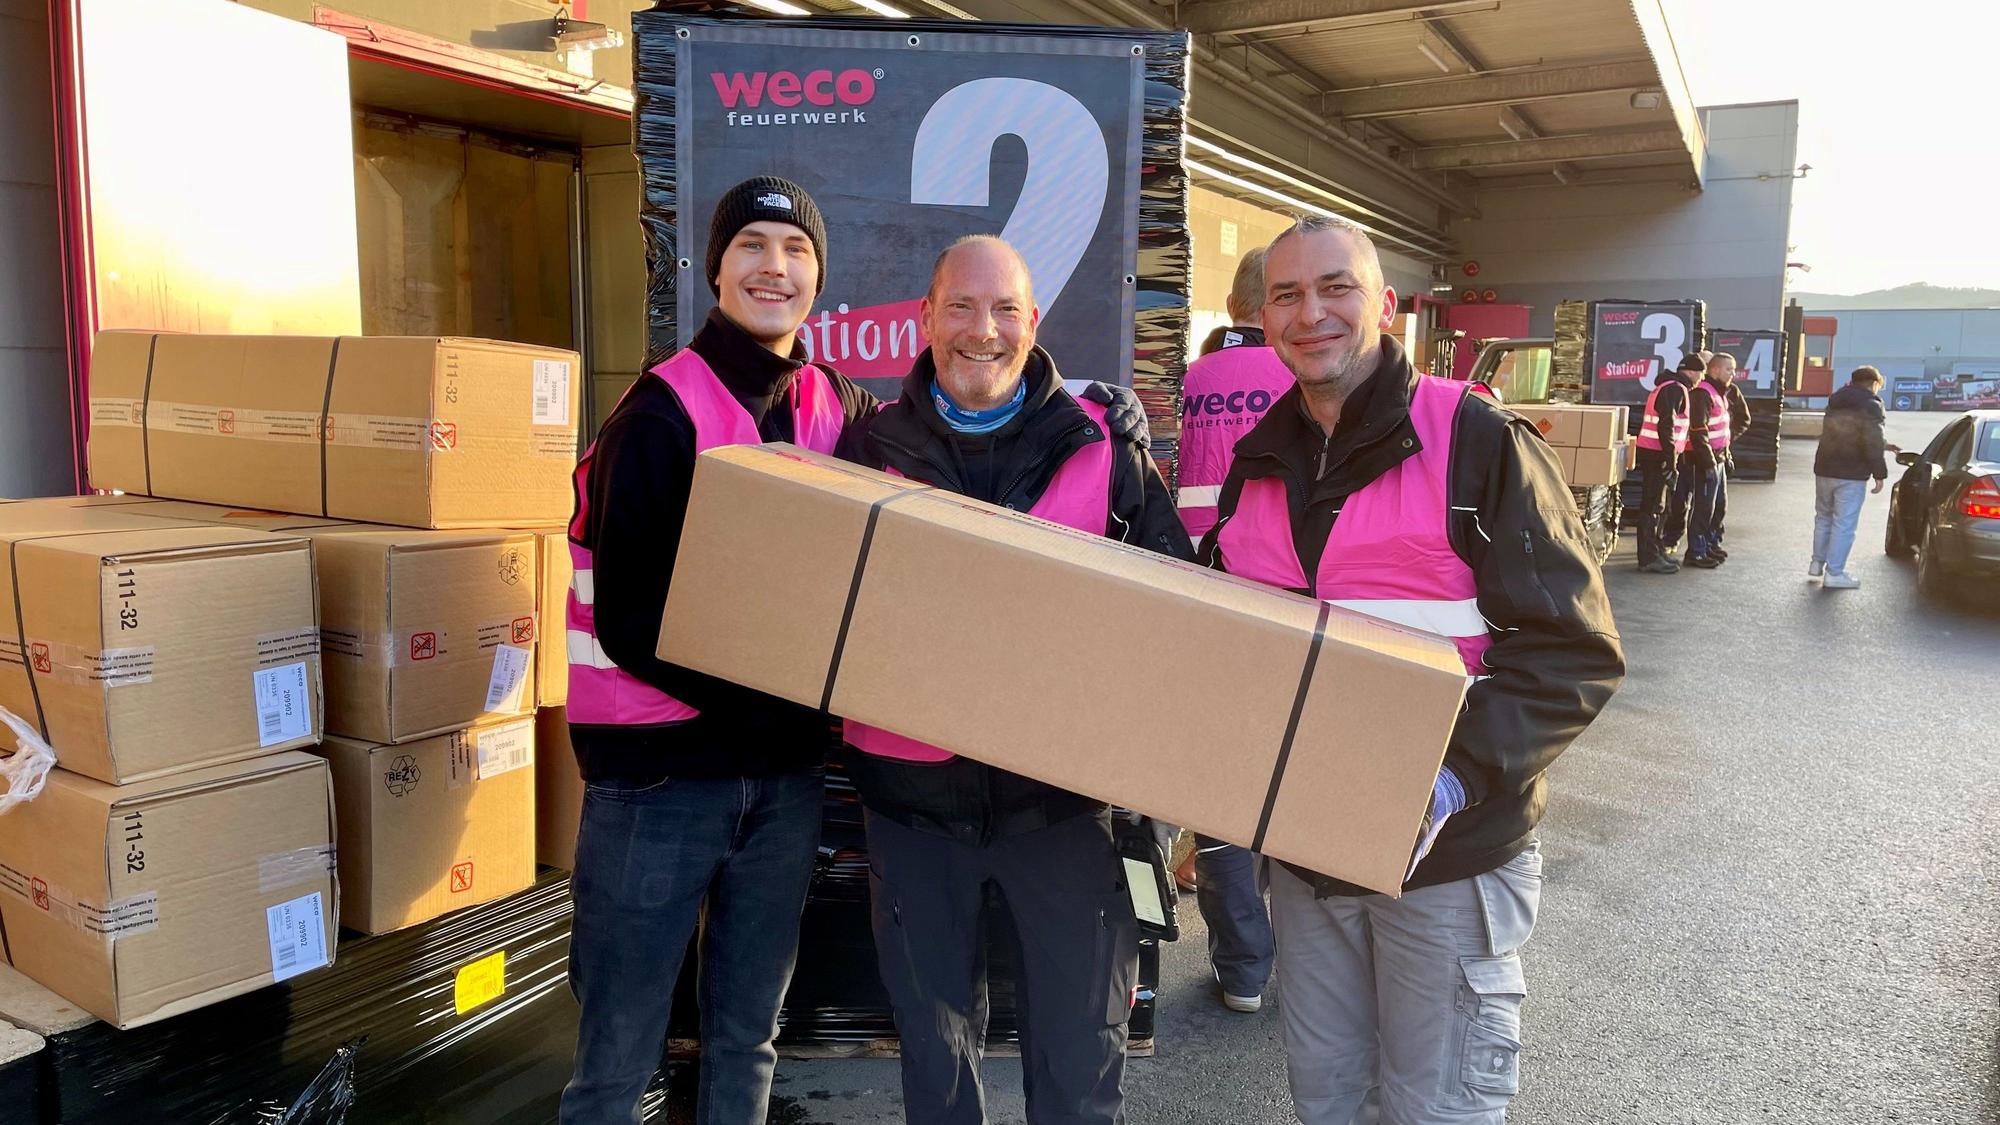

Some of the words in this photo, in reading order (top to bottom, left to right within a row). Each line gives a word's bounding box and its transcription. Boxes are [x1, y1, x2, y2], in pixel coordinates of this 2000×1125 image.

[727, 109, 867, 126] feuerwerk
[910, 77, 1110, 396] 2
[1606, 359, 1645, 376] Station
[1639, 312, 1685, 391] 3
[1744, 338, 1776, 390] 4
[445, 353, 459, 404] 111-32
[1187, 416, 1261, 430] euerwerk
[117, 568, 138, 631] 111-32
[283, 689, 293, 717] 209902
[388, 766, 417, 782] REZY
[124, 811, 146, 874] 111-32
[298, 920, 308, 947] 209902
